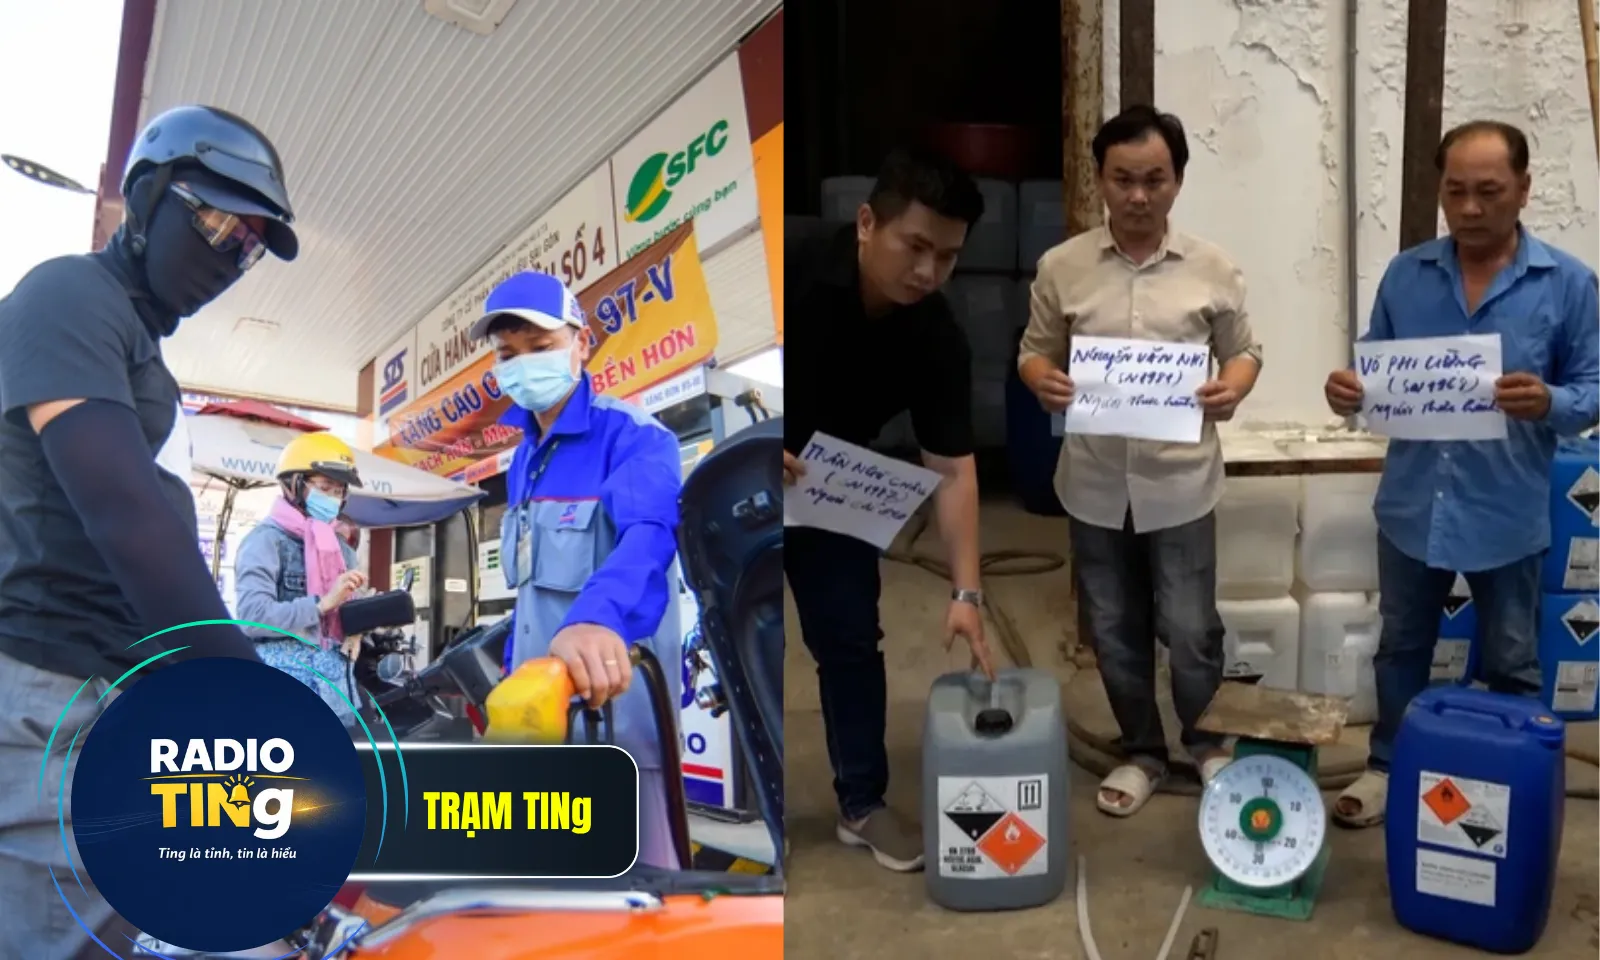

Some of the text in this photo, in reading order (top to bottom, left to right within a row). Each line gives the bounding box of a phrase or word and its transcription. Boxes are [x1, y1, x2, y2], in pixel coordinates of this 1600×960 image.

[666, 119, 728, 187] SFC
[561, 222, 587, 288] SỐ
[592, 226, 605, 266] 4
[441, 383, 483, 423] CAO
[596, 254, 674, 334] 97-V
[591, 355, 636, 394] BỀN
[641, 324, 696, 369] HƠN
[1387, 355, 1418, 375] PHI
